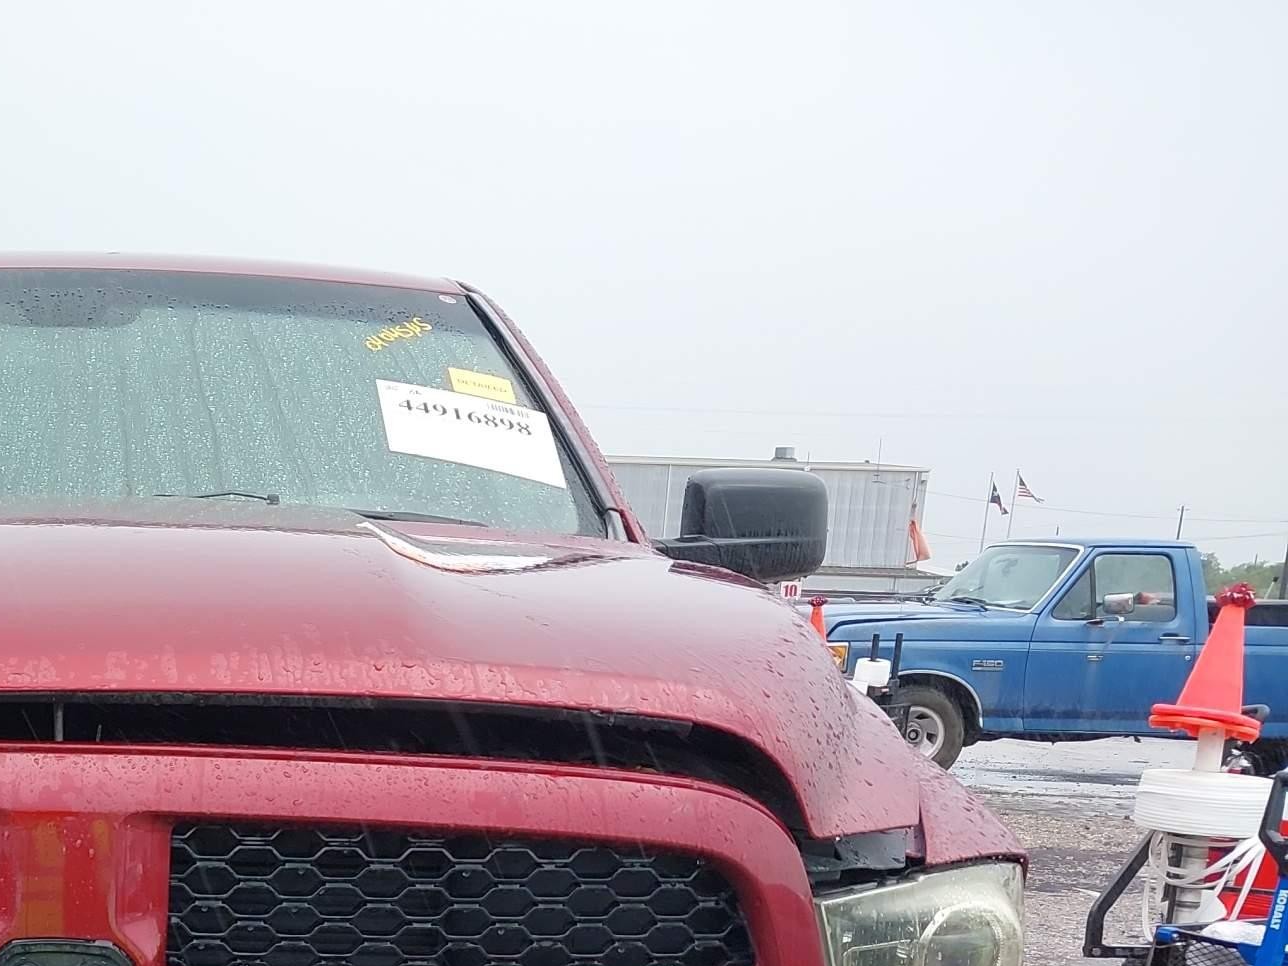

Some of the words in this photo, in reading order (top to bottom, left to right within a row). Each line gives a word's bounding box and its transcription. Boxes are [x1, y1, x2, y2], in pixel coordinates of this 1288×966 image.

[398, 399, 533, 436] 44916898
[783, 585, 798, 597] 10
[1270, 889, 1288, 930] KOBALT
